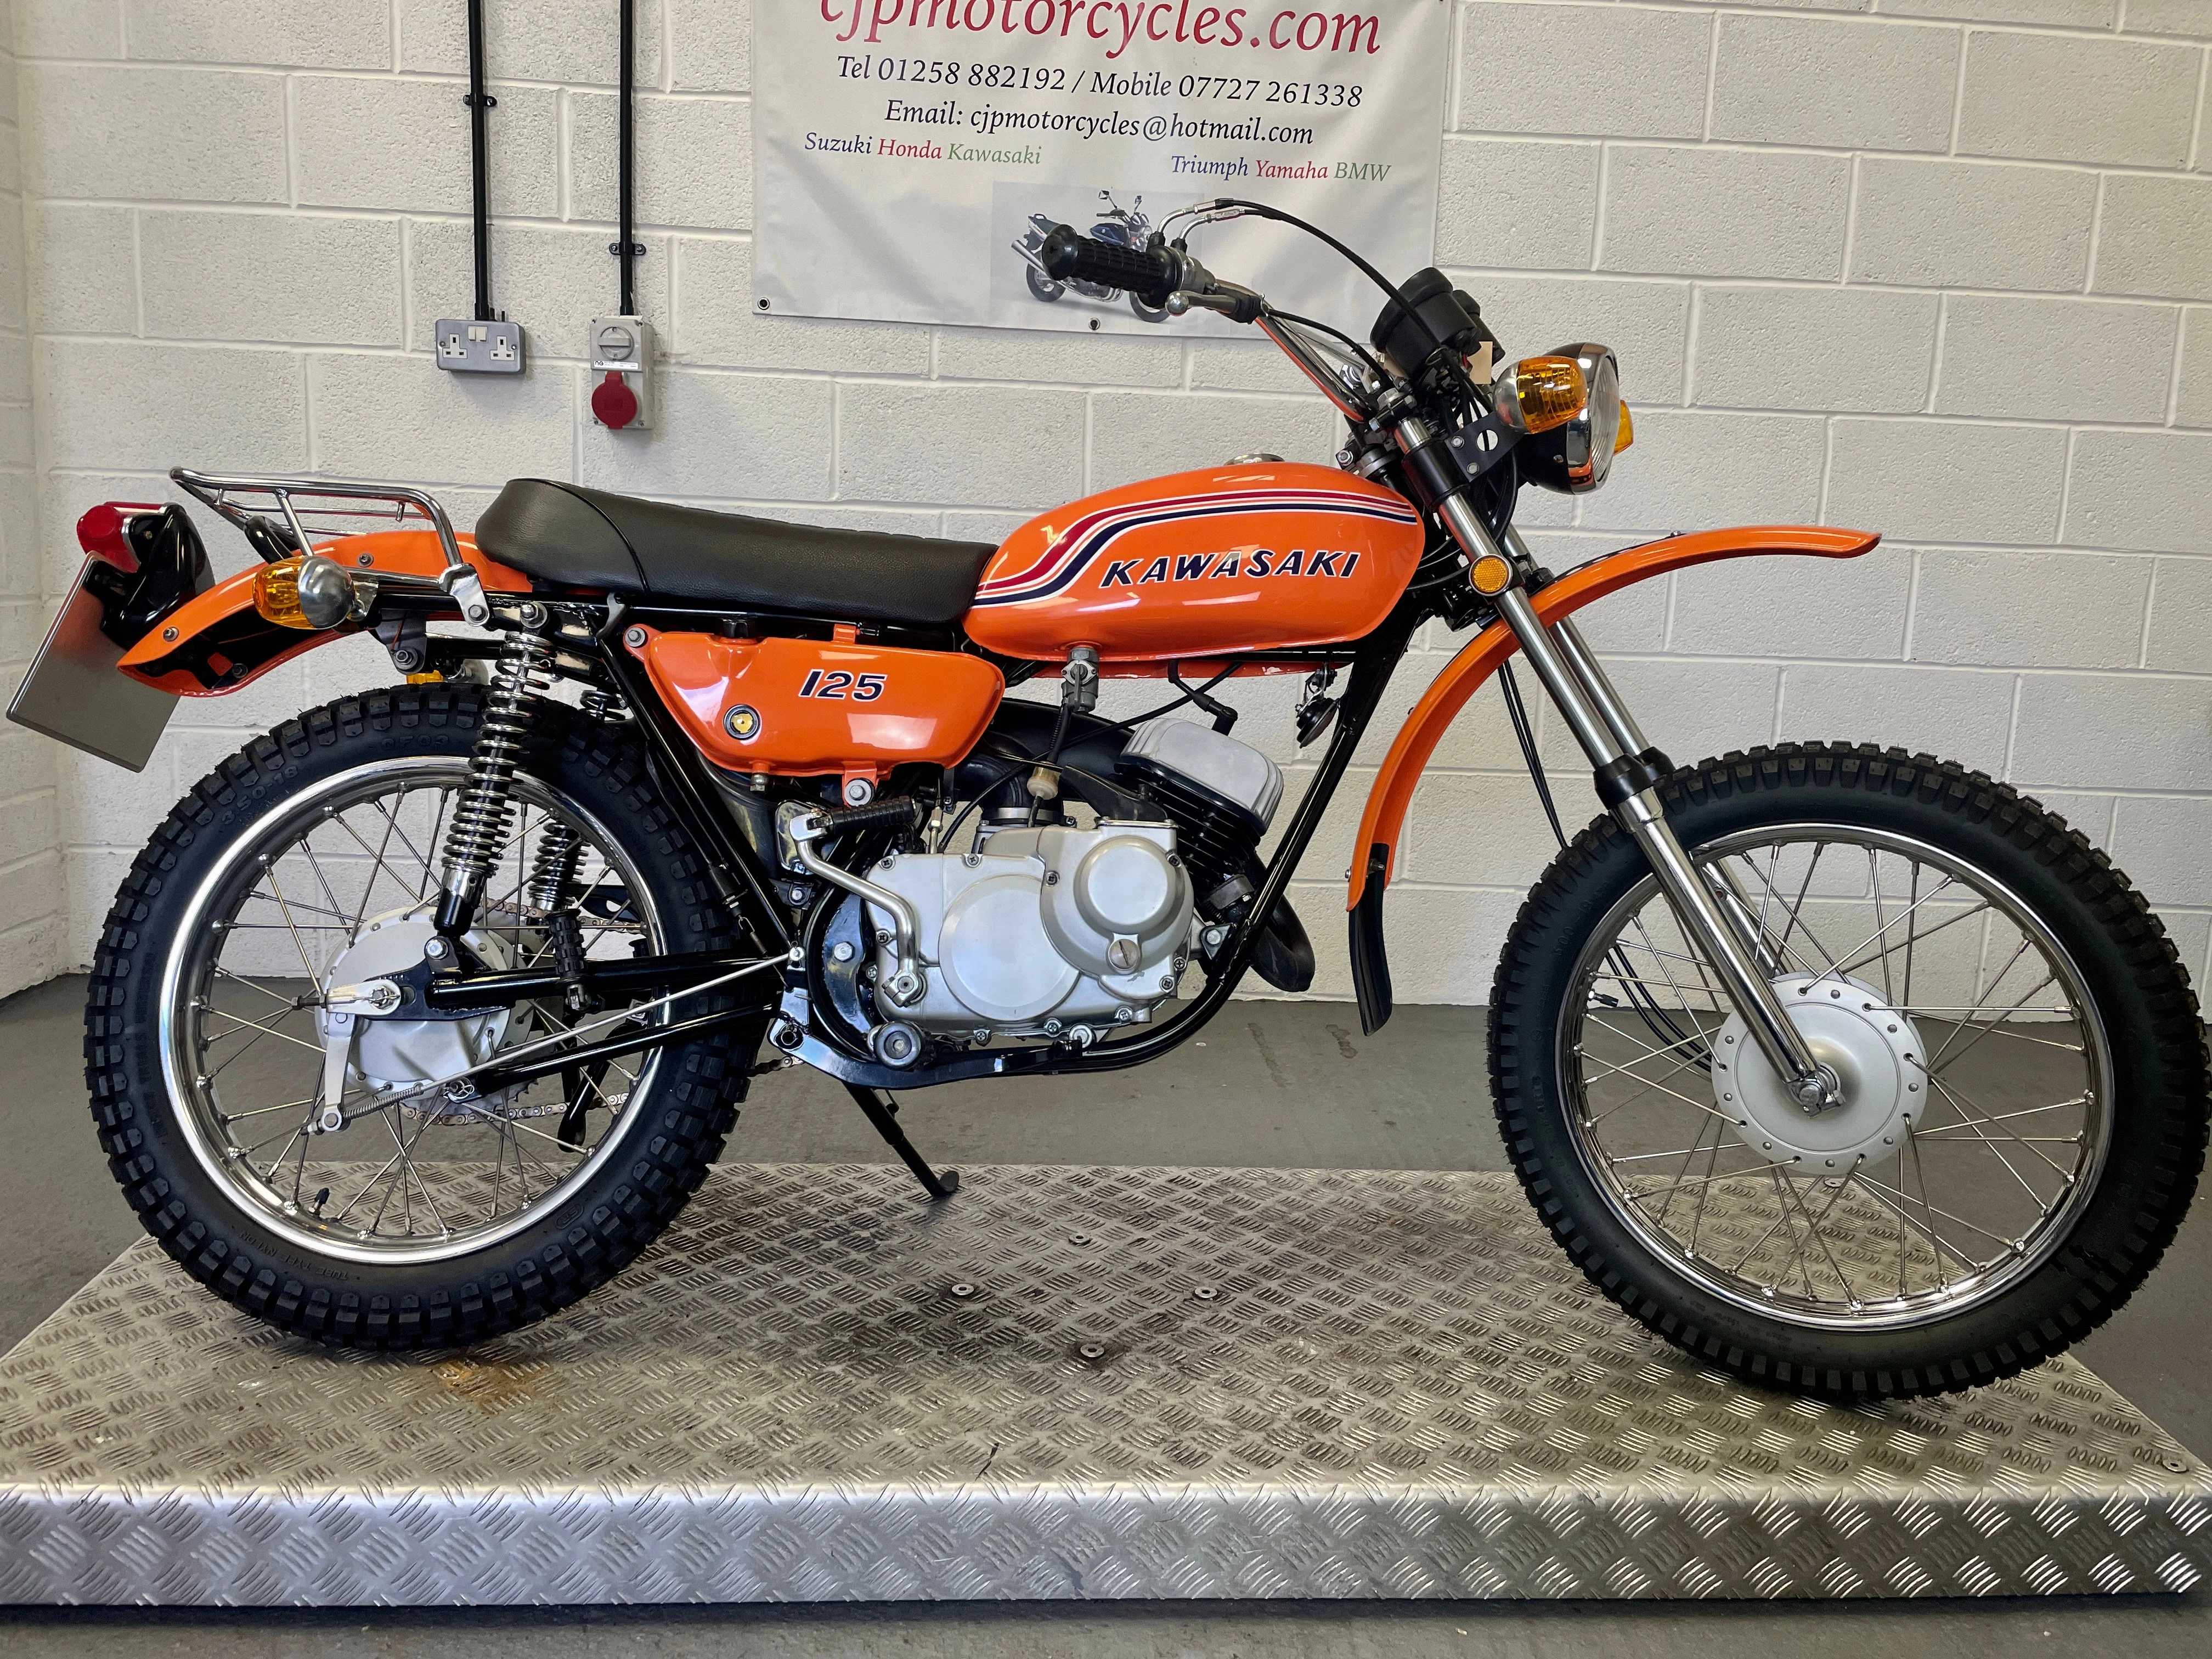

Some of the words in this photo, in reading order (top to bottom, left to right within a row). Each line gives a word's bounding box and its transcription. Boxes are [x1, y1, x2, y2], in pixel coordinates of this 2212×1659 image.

[821, 0, 1380, 59] cjpmotorcycles.com
[838, 56, 871, 79] Tel
[879, 58, 960, 84] 01258
[968, 64, 1065, 90] 882192
[1071, 70, 1086, 93] /
[1090, 72, 1171, 97] Mobile
[1179, 75, 1260, 100] 07727
[1266, 81, 1362, 107] 261338
[884, 100, 963, 126] Email:
[971, 104, 1313, 144] cjpmotorcycles@hotmail.com
[805, 132, 872, 154] Suzuki
[877, 139, 942, 159] Honda
[947, 144, 1042, 164] Kawasaki
[1171, 155, 1248, 180] Triumph
[1256, 160, 1328, 179] Yamaha
[1334, 162, 1392, 181] BMW
[1098, 549, 1361, 588] KAWASAKI
[798, 669, 888, 702] 125
